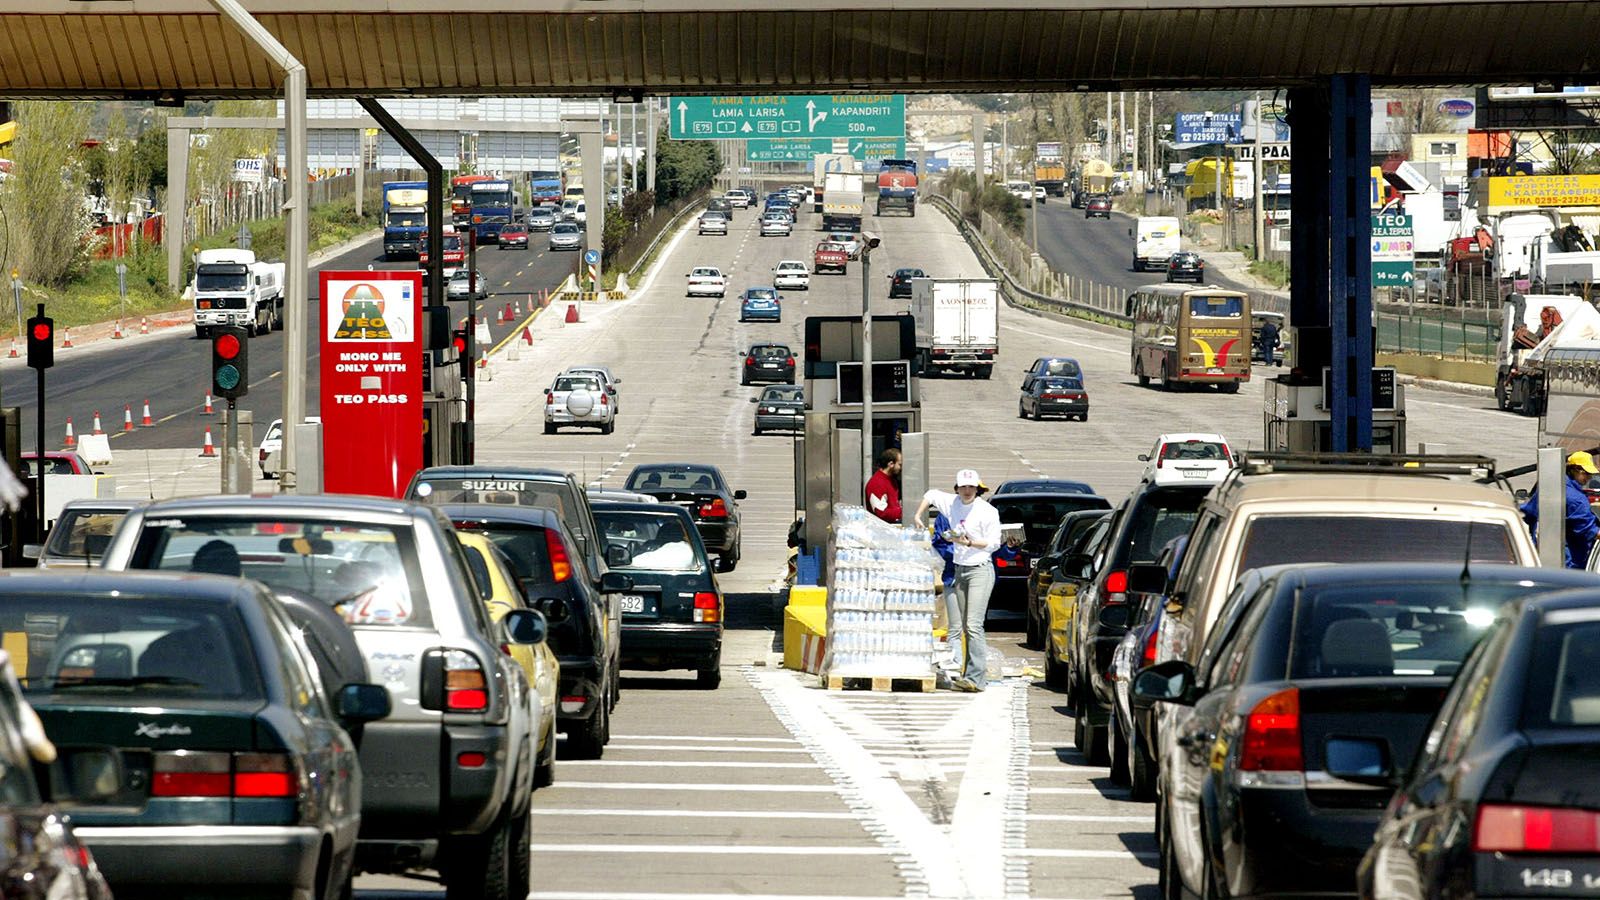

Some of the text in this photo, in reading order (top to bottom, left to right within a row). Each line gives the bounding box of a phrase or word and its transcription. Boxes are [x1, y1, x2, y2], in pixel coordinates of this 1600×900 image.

[712, 107, 785, 118] LAMIA LARISA
[832, 107, 890, 116] KAPANDRITI
[695, 123, 710, 132] E75
[760, 123, 775, 131] E75
[848, 122, 866, 132] 500
[1241, 146, 1290, 158] ΠΡΔΑ
[344, 317, 385, 328] TEO
[336, 330, 391, 338] PASS
[340, 352, 401, 361] MONO ME
[335, 363, 406, 372] ONLY WITH
[334, 394, 408, 404] TEO PASS
[461, 480, 525, 491] SUZUKI
